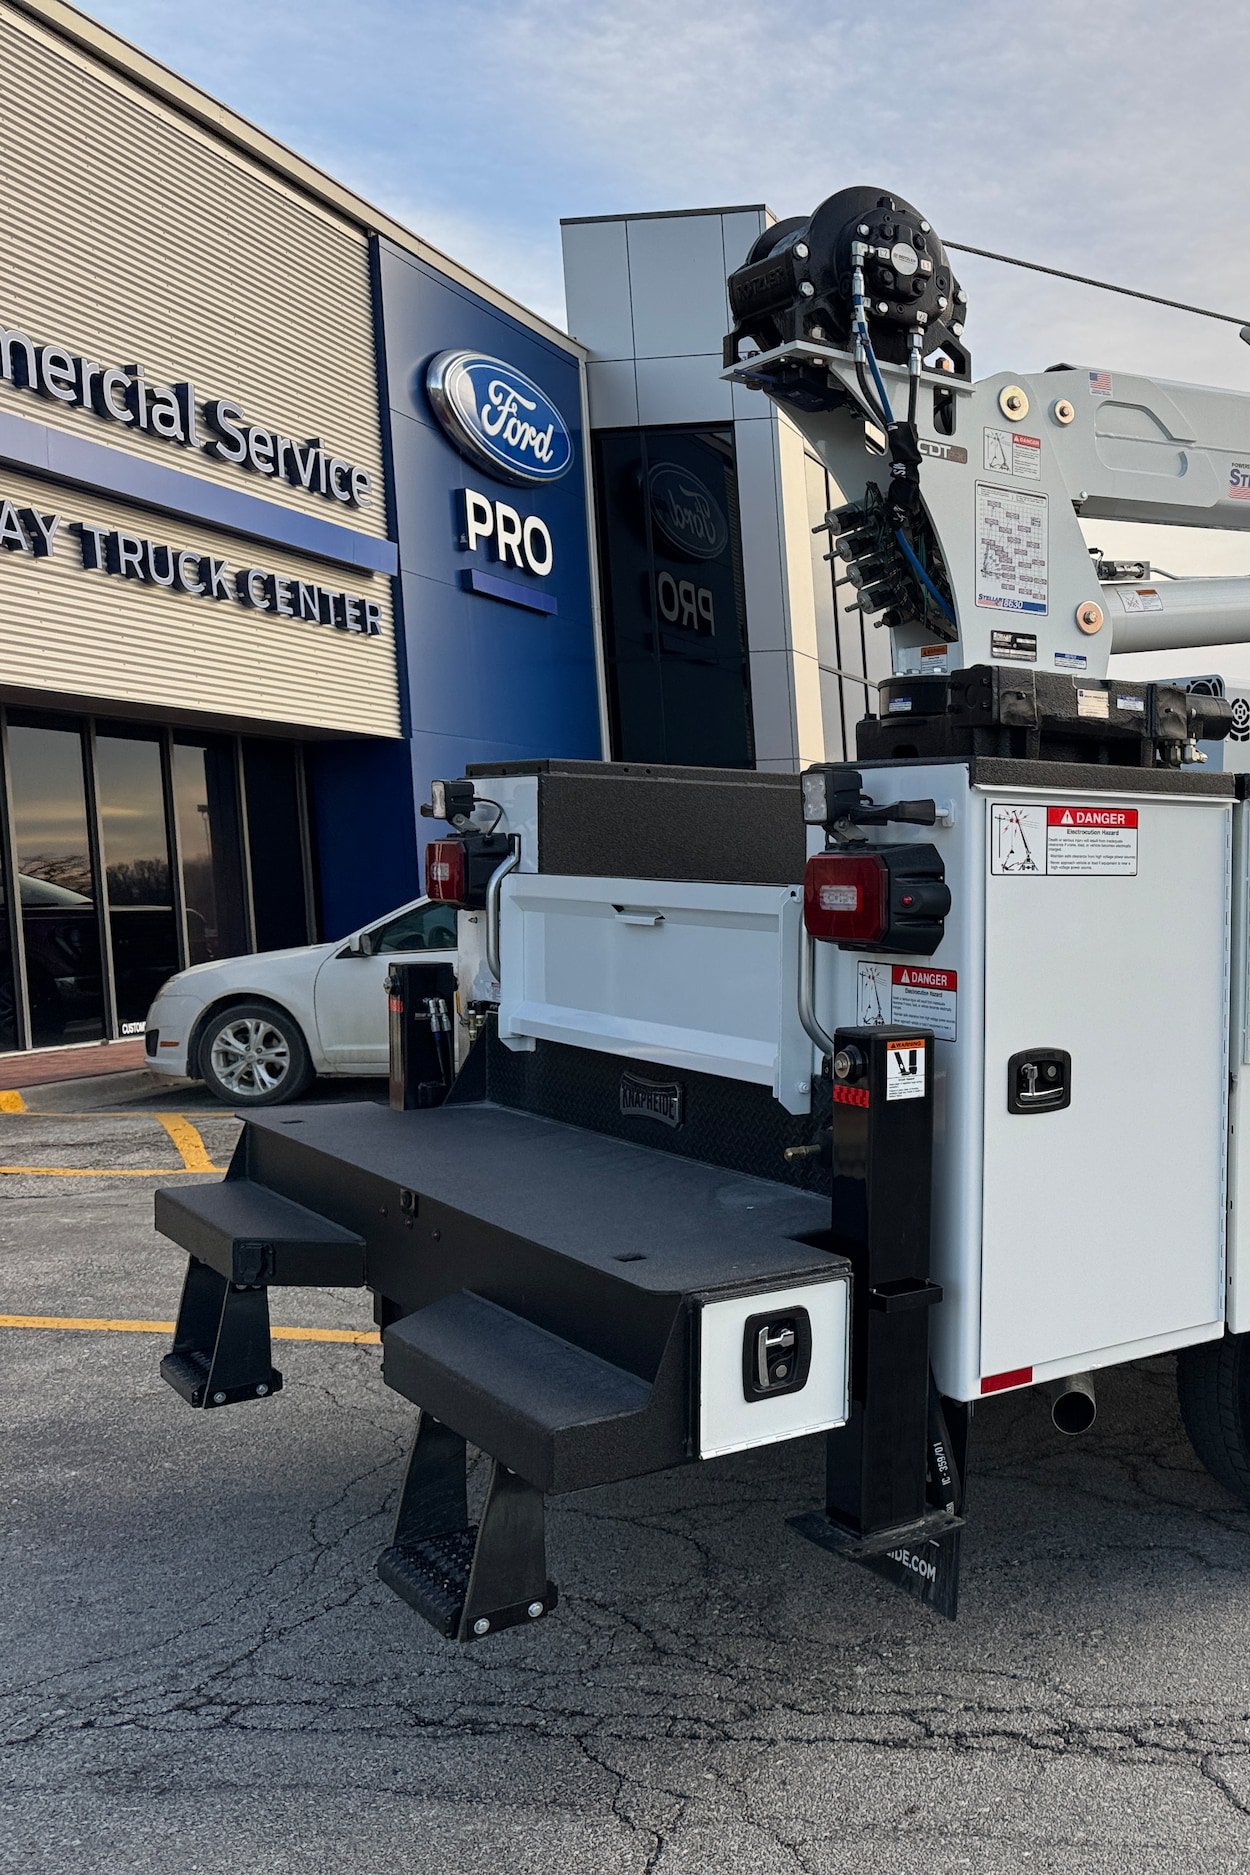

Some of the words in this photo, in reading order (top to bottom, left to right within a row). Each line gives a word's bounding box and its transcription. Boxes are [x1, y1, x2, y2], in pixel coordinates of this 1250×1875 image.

[216, 399, 374, 509] Service
[480, 379, 554, 463] Ford
[465, 488, 553, 577] PRO
[82, 522, 234, 600] TRUCK
[247, 568, 383, 636] CENTER
[1003, 599, 1024, 609] 8630
[1076, 812, 1126, 825] DANGER
[911, 971, 948, 986] DANGER
